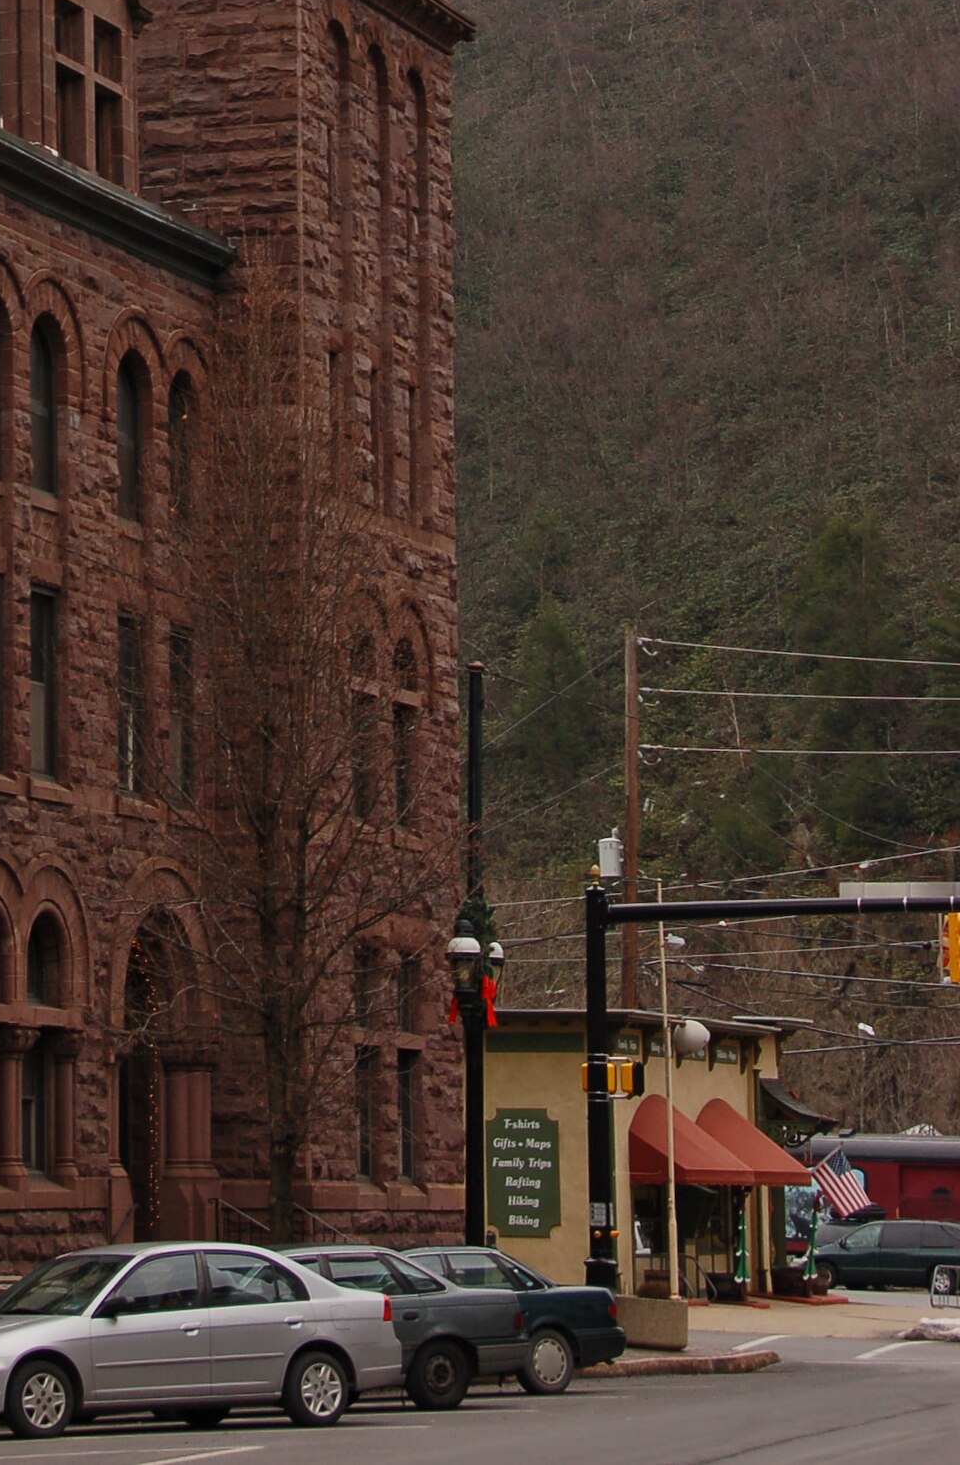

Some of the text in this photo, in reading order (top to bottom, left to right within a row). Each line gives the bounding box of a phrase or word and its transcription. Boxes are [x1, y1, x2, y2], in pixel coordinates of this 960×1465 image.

[503, 1118, 540, 1129] T-shirts
[493, 1137, 552, 1150] Gifts Maps
[492, 1157, 552, 1170] Family Trips
[505, 1176, 541, 1189] Rafting
[508, 1195, 540, 1208] Hiking
[508, 1215, 540, 1228] Biking
